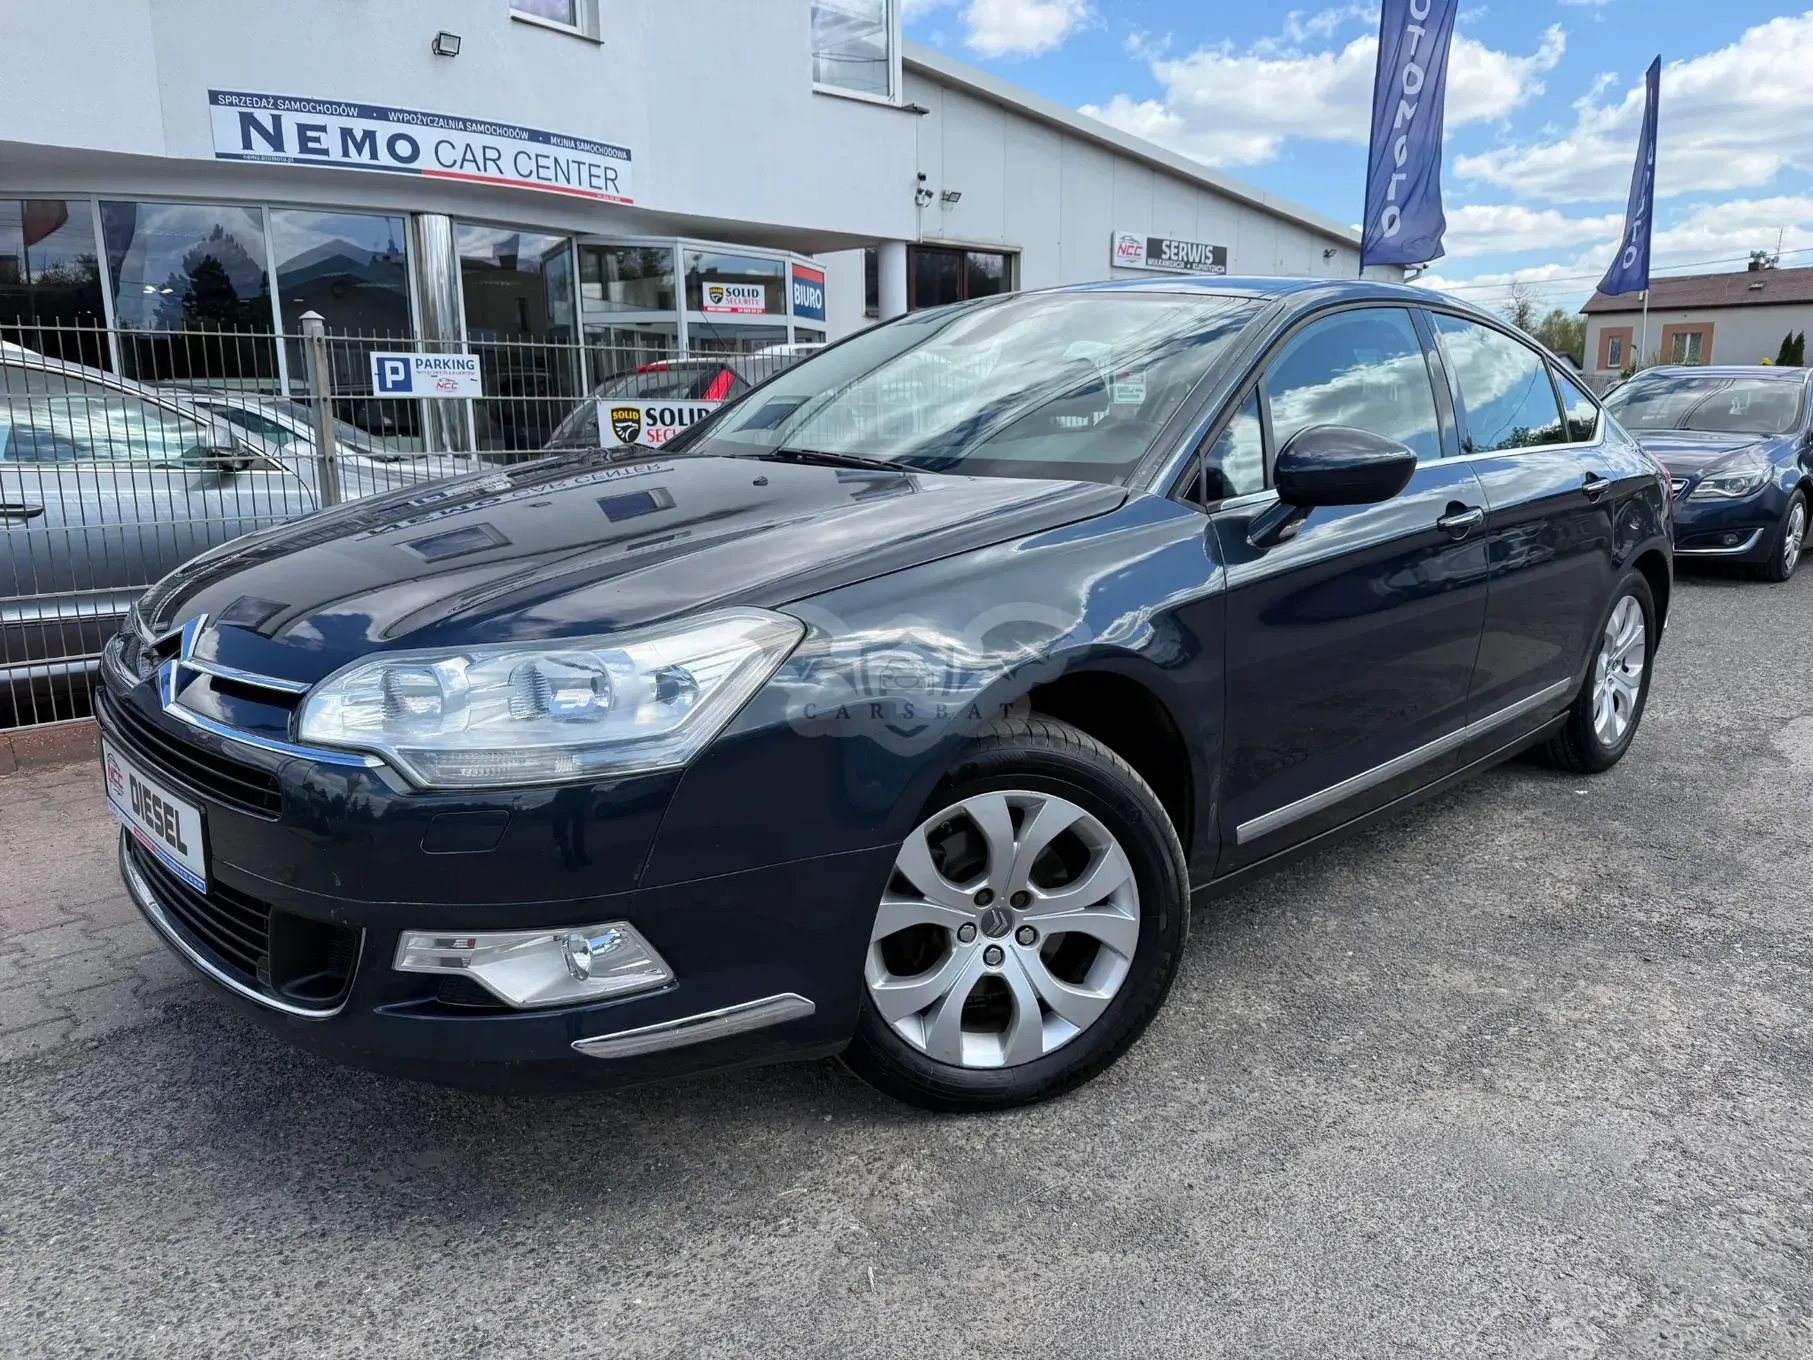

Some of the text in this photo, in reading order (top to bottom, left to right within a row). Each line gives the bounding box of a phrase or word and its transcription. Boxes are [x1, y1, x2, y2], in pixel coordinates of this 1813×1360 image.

[218, 94, 628, 160] SPRZEDAŻ SAMOCHODÓW WYPOŻYCZALNIA SAMOCHODÓW MYJNIA SAMOCHODOWA
[238, 111, 620, 194] NEMO CAR CENTER
[1117, 244, 1143, 257] NCC
[1161, 240, 1214, 264] SERWIS
[725, 287, 759, 298] SOLID
[726, 298, 759, 306] SECURITY
[793, 284, 822, 309] BIURO
[384, 361, 405, 388] P
[415, 358, 475, 370] PARKING
[612, 410, 639, 420] SOLID
[129, 772, 188, 857] DIESEL
